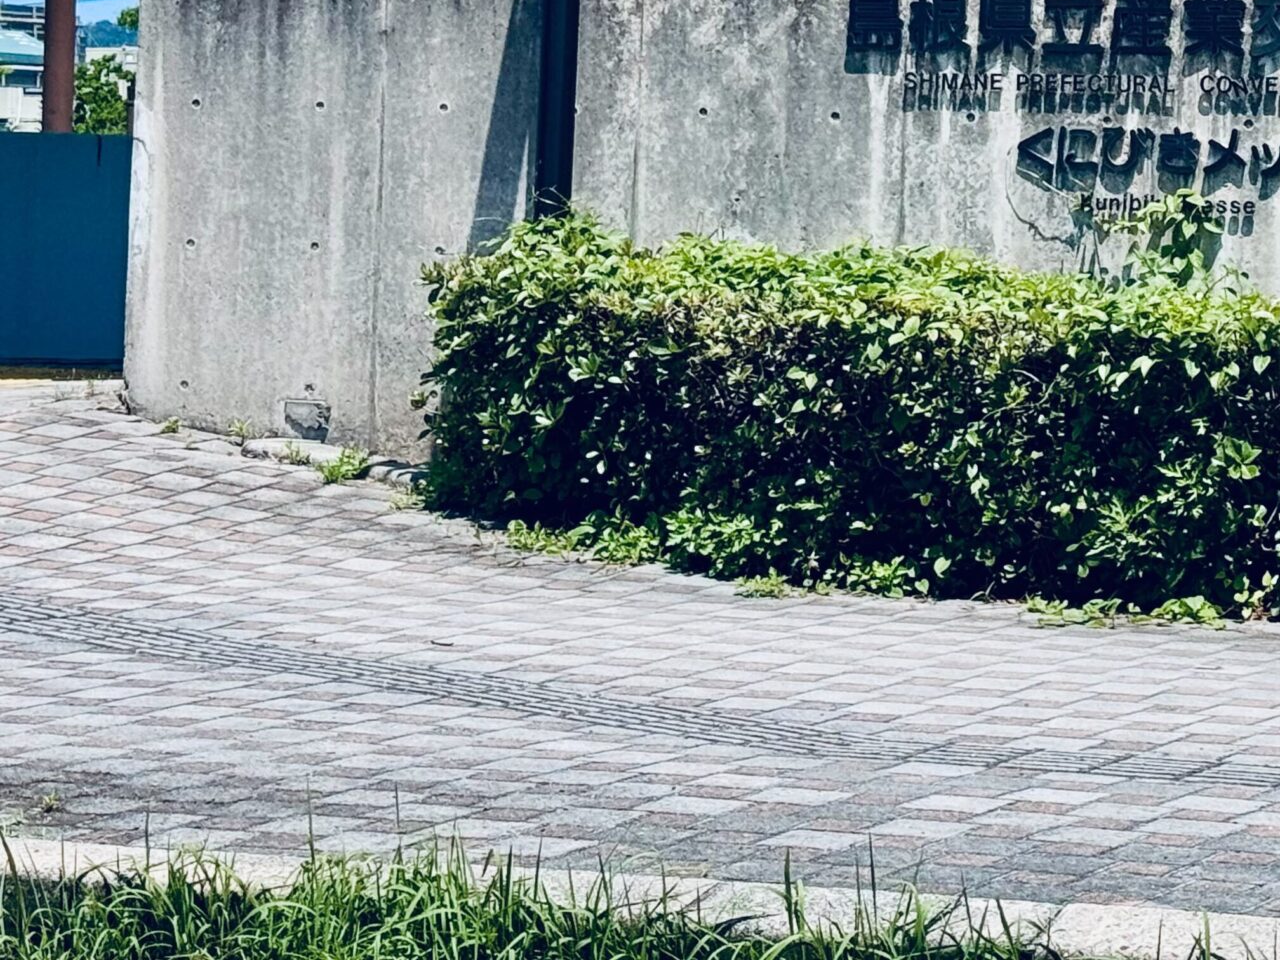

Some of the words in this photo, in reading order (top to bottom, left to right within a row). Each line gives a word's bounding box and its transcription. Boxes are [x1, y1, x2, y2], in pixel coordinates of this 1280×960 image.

[904, 72, 1002, 92] SHIMANE
[1016, 73, 1175, 93] PREFECTURAL
[1178, 195, 1256, 215] esse
